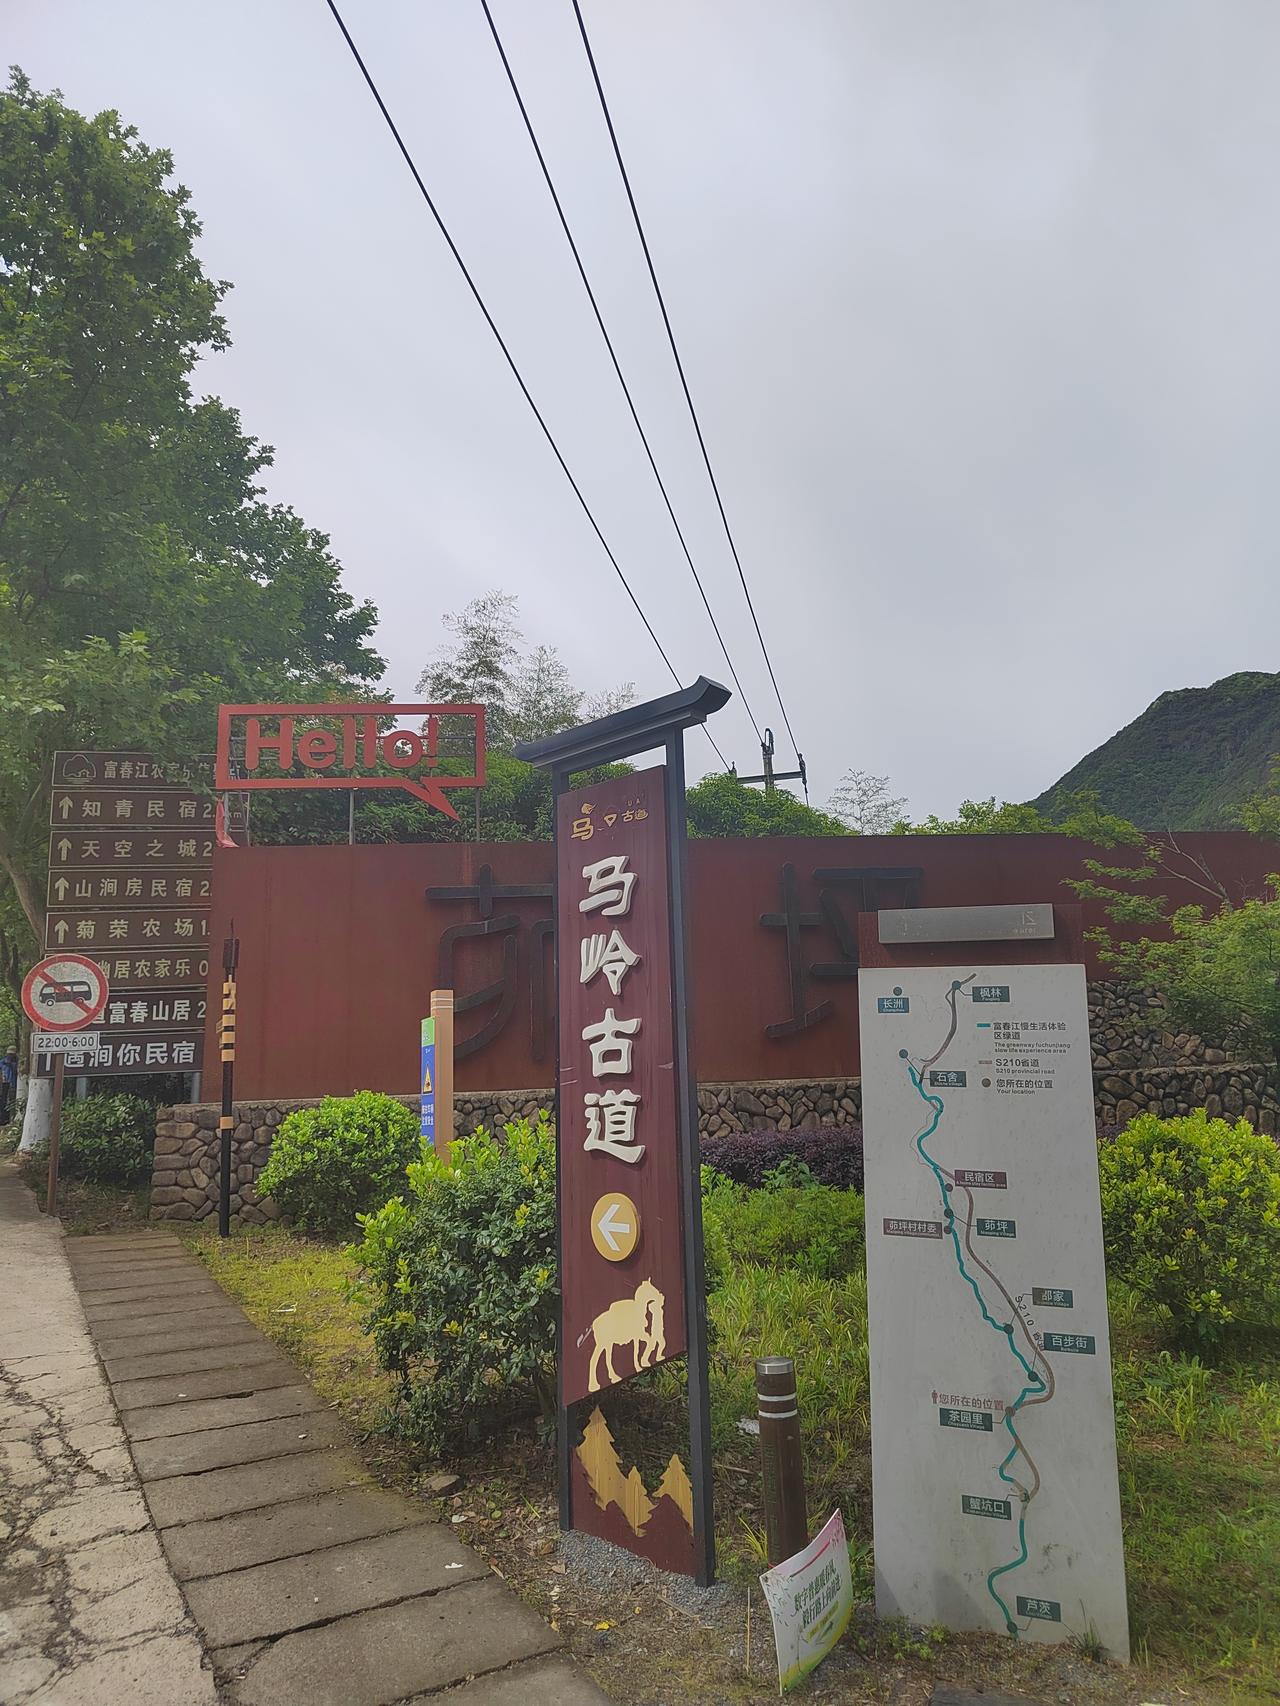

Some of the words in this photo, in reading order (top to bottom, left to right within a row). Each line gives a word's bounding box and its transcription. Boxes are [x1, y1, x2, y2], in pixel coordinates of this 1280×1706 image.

[245, 715, 438, 770] Hello!
[82, 799, 198, 819] 知青民宿
[81, 839, 197, 858] 天空之城
[75, 878, 193, 898] 山涧房民宿
[76, 918, 194, 939] 菊荣农场
[980, 987, 1002, 997] 枫林
[579, 855, 647, 1164] 马岭古道
[883, 999, 903, 1009] 长洲
[993, 1022, 1067, 1031] 富春江慢生活体验
[994, 1031, 1021, 1040] 区绿道
[995, 1058, 1040, 1068] S210省道
[936, 1072, 957, 1082] 石舍
[996, 1079, 1053, 1089] 您所在的位置
[964, 1172, 995, 1183] 民宿区
[1051, 1335, 1088, 1349] 百步街
[939, 1393, 1004, 1411] 您所在的位置
[948, 1410, 984, 1425] 茶园里
